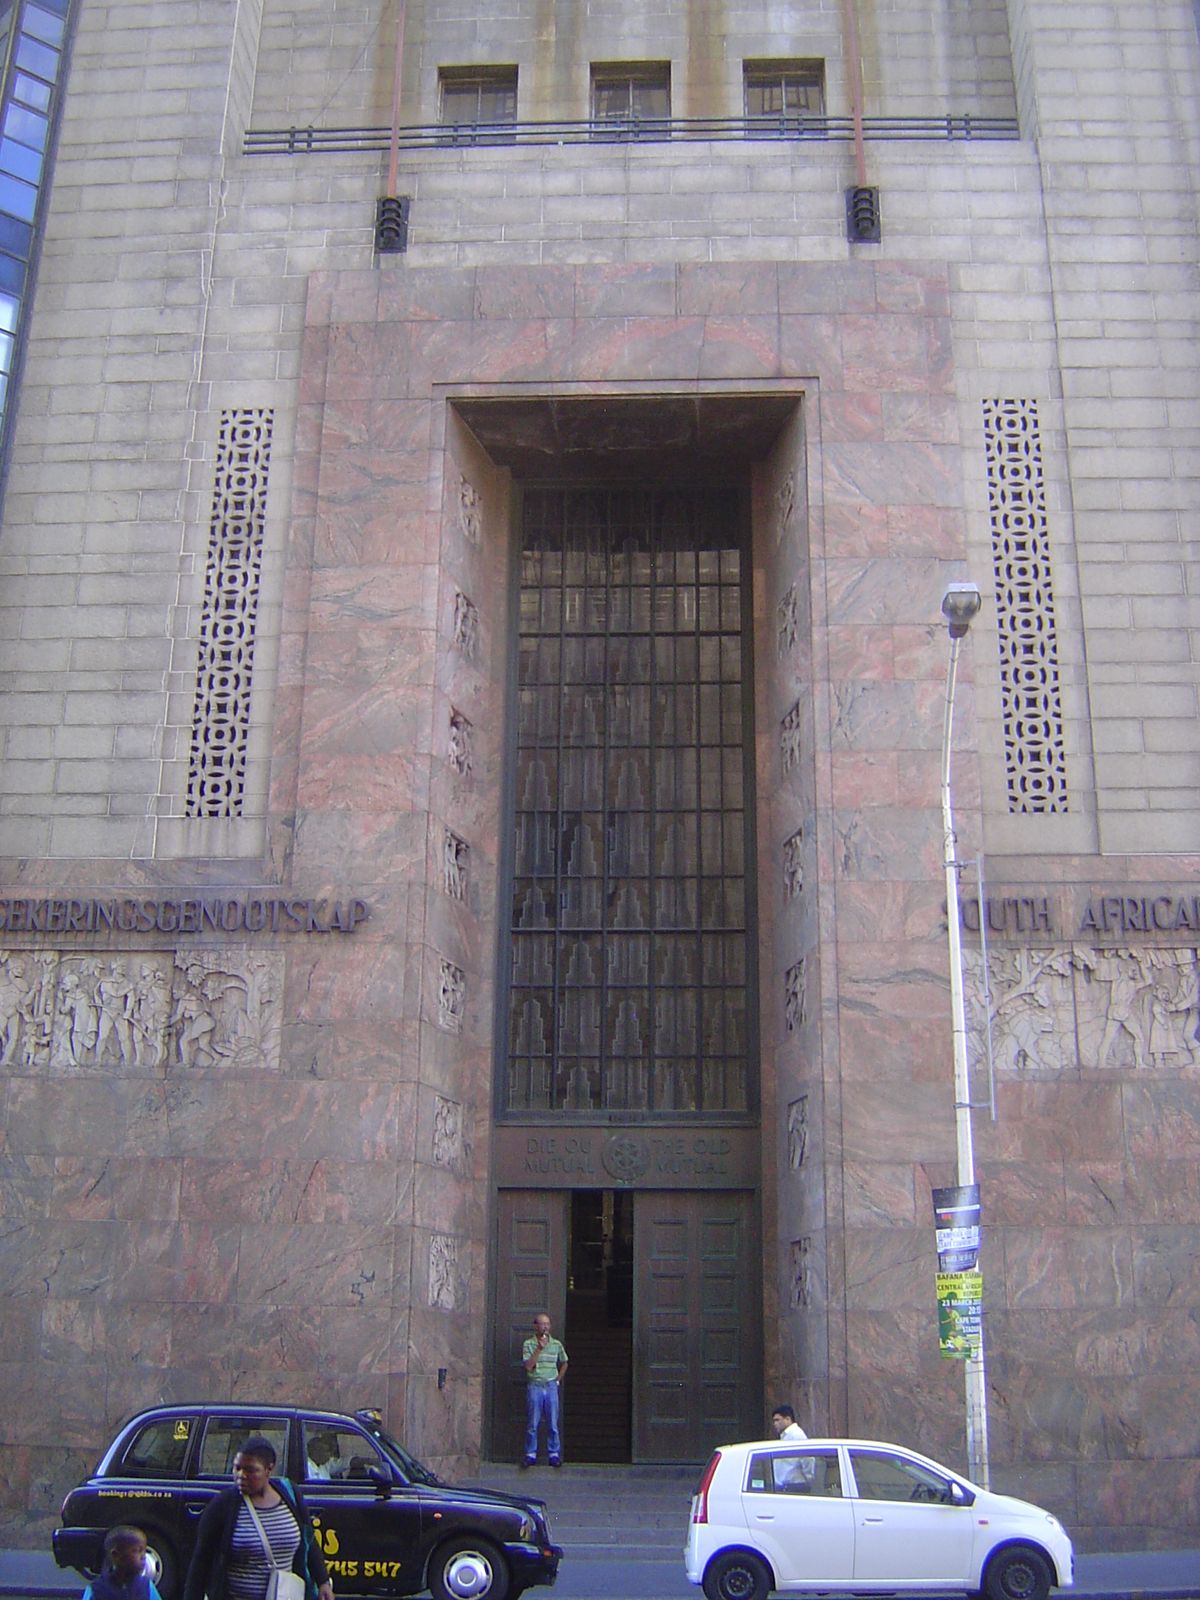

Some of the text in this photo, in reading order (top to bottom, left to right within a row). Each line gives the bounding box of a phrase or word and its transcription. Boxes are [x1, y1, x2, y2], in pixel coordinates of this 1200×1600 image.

[527, 1137, 592, 1155] DIE OU
[652, 1138, 731, 1155] THE OLD
[524, 1157, 595, 1174] MUTUAL
[656, 1158, 729, 1174] MUTUAL
[936, 1273, 963, 1281] BAFANA
[324, 1560, 401, 1578] 745 547
